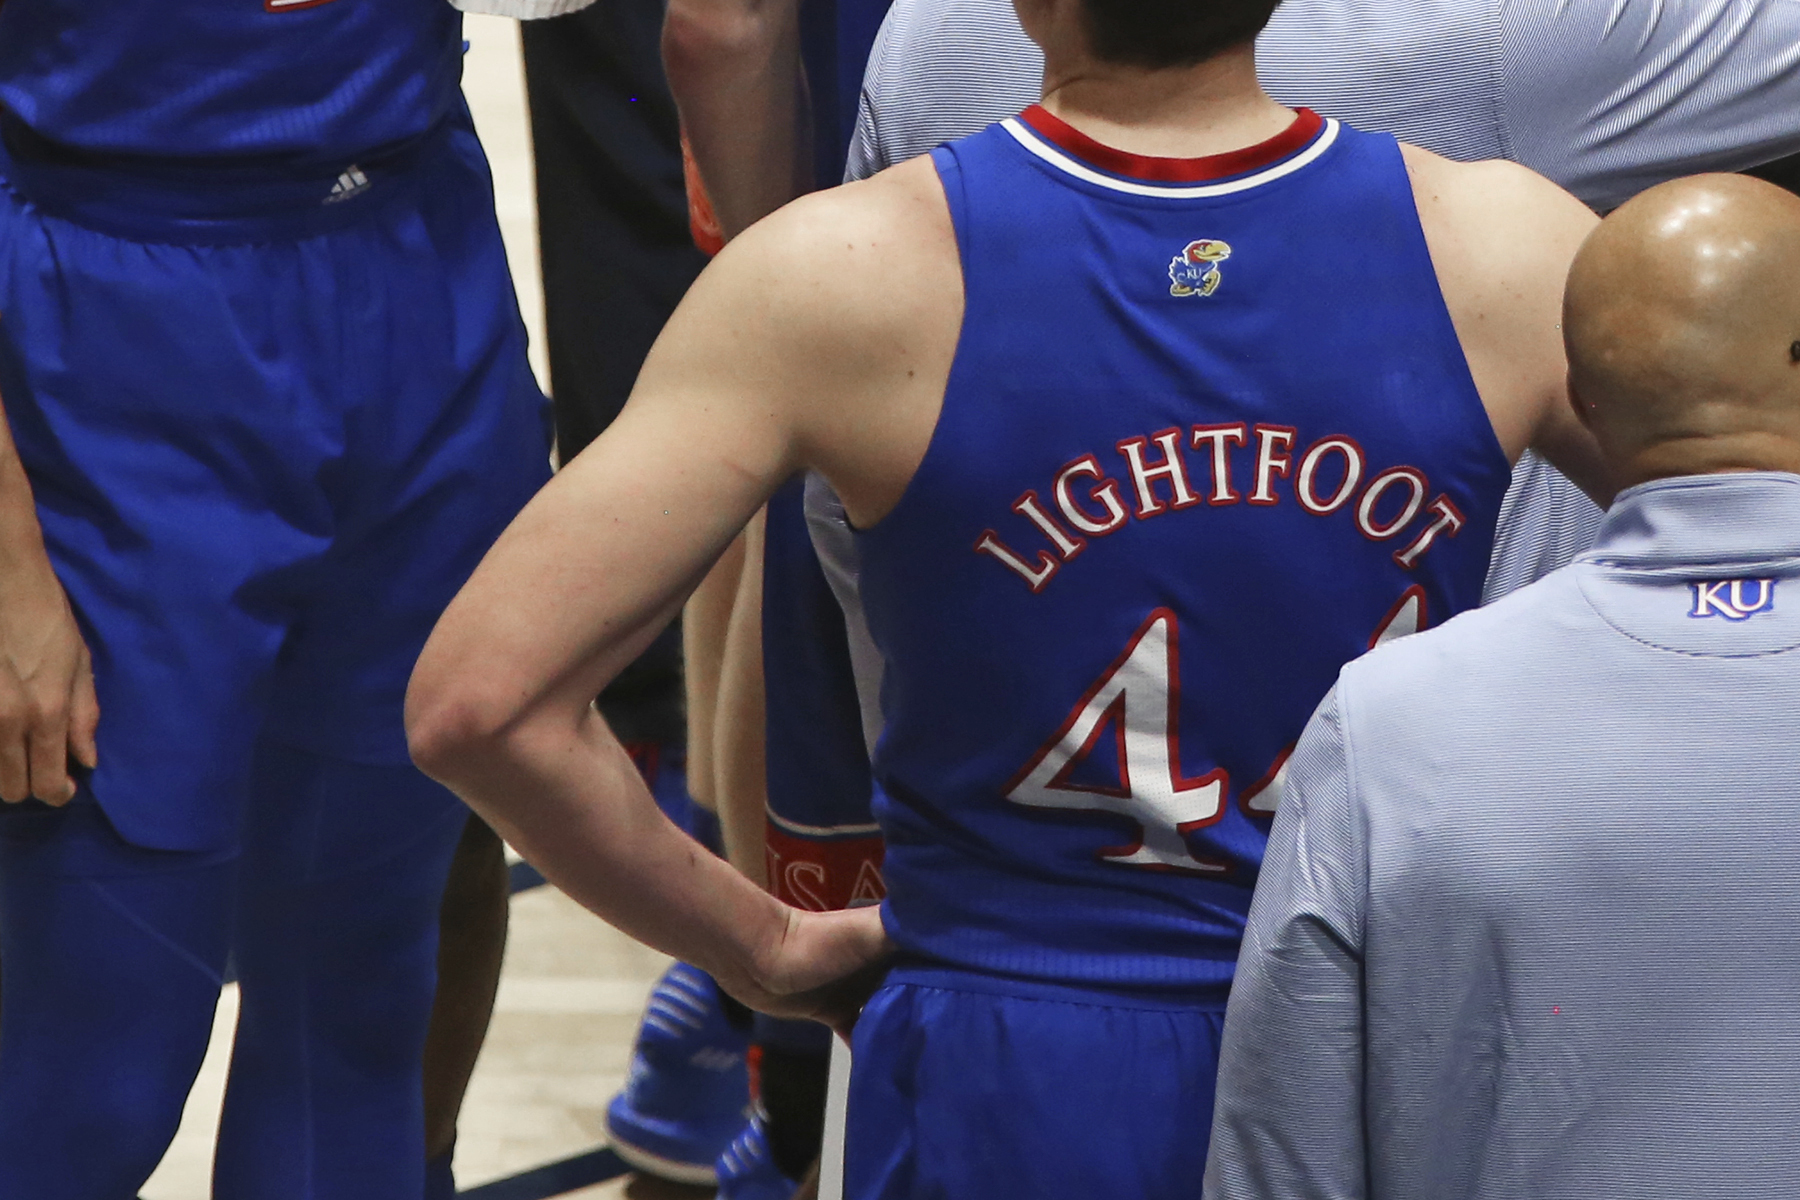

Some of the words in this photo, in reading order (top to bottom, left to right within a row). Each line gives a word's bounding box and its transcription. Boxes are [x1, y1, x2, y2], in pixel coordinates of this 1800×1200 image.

[974, 421, 1466, 593] LIGHTFOOT
[1689, 577, 1776, 621] KU
[1003, 584, 1428, 873] 4
